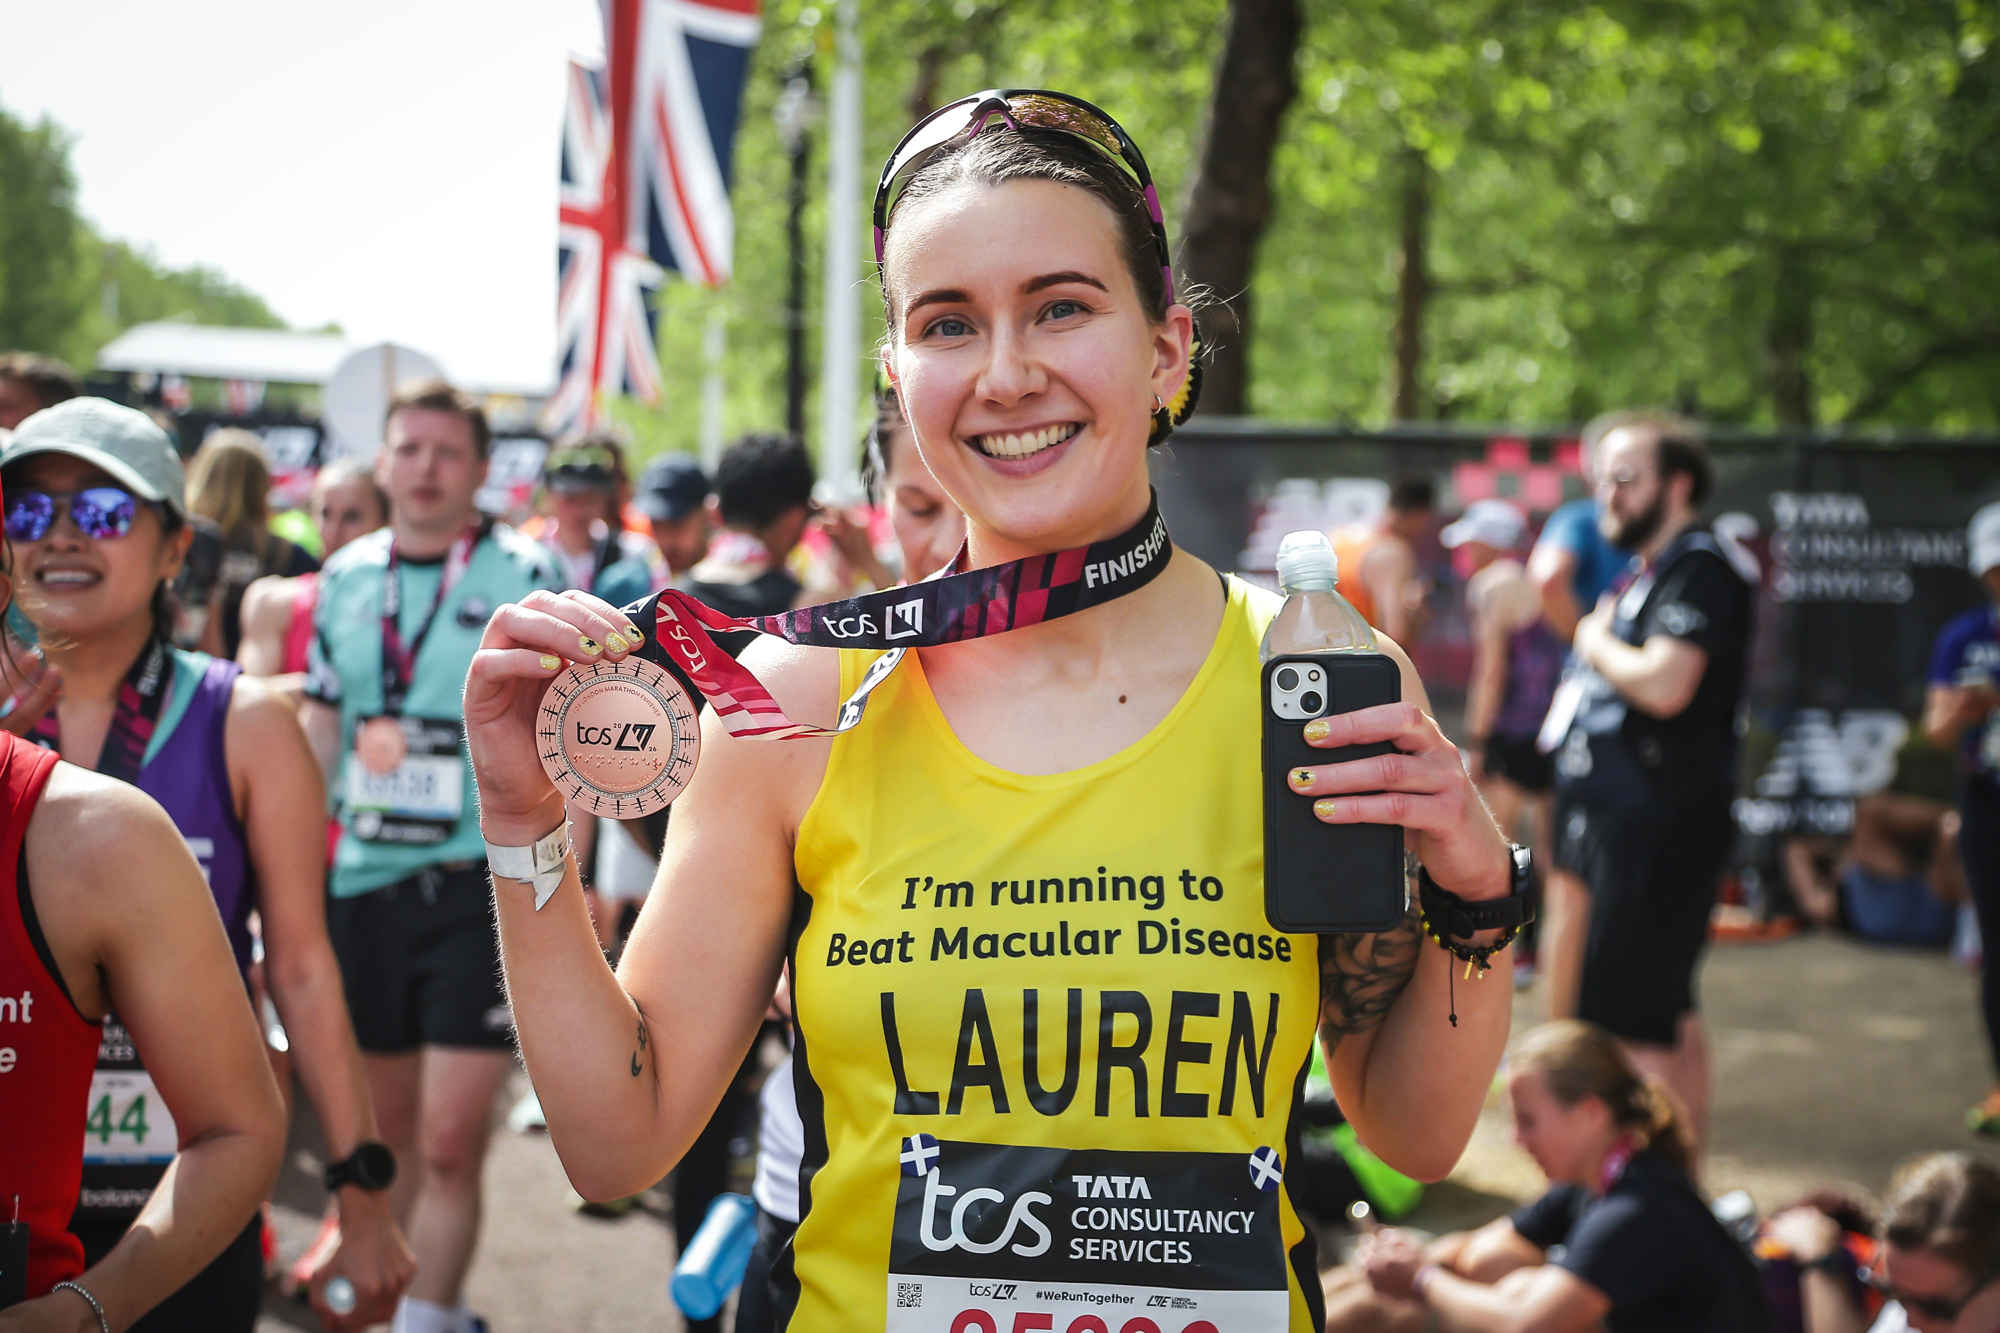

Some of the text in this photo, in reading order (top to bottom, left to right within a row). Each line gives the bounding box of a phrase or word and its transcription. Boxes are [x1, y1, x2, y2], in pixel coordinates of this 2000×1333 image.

[1085, 516, 1169, 588] FINISHER
[823, 613, 879, 639] tcs
[577, 721, 612, 746] tcs
[990, 867, 1165, 910] running
[1180, 868, 1225, 902] to
[826, 916, 1293, 967] Beat Macular Disease
[879, 988, 1281, 1119] LAUREN
[1071, 1174, 1152, 1200] TATA
[919, 1166, 1052, 1257] tcs
[1070, 1206, 1256, 1235] CONSULTANCY
[1069, 1237, 1194, 1266] SERVICES
[970, 1282, 991, 1296] tcs
[1035, 1290, 1135, 1306] #WeRunTogether
